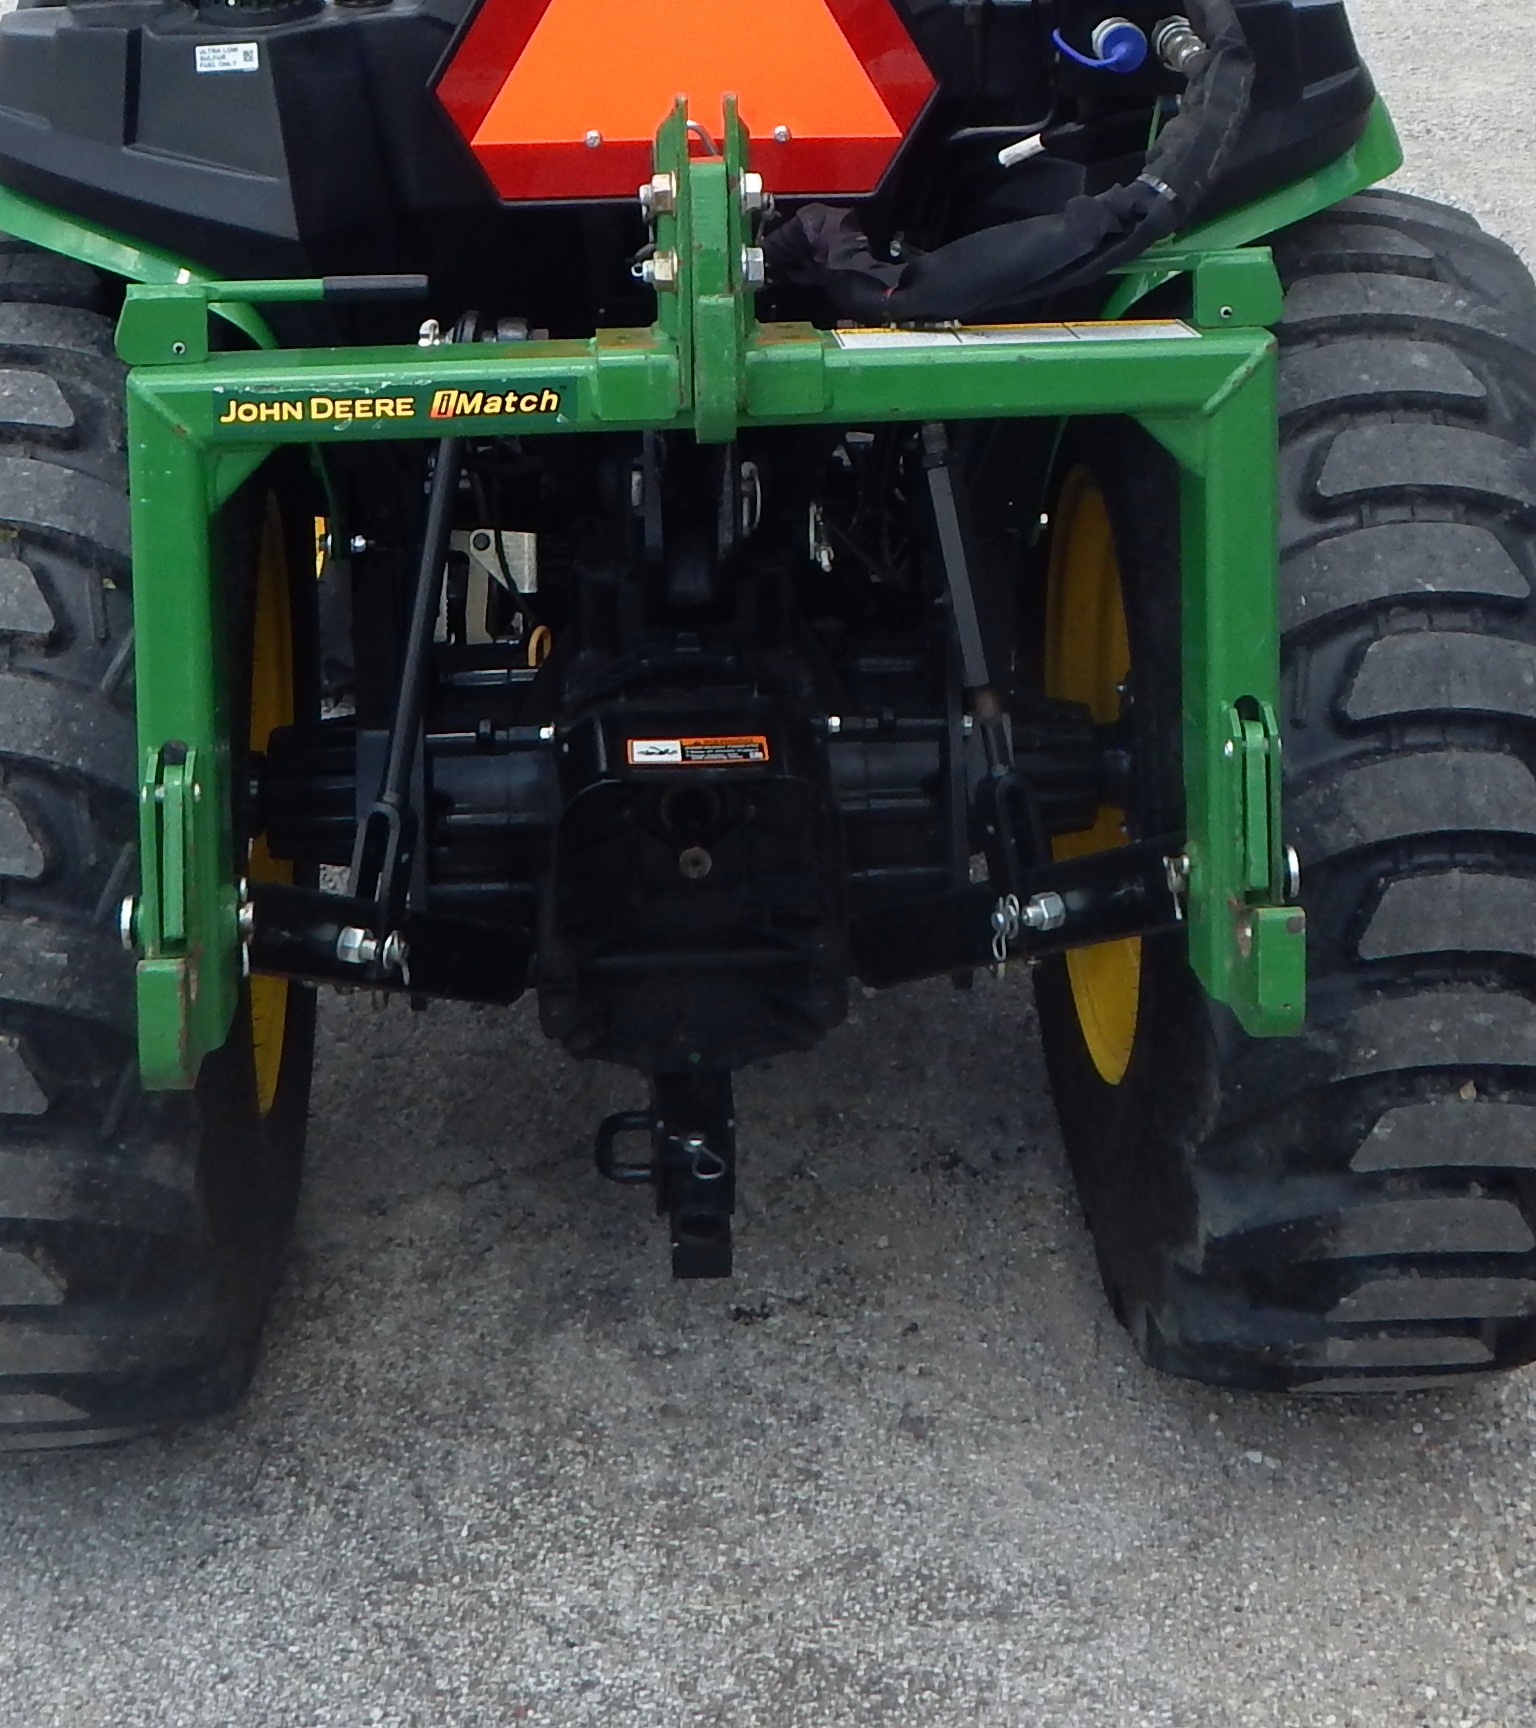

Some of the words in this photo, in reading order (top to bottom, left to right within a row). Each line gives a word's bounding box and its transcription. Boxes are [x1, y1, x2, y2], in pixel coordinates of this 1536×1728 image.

[220, 400, 303, 423] JOHN
[310, 396, 415, 419] DEERE
[429, 389, 559, 419] iMatch
